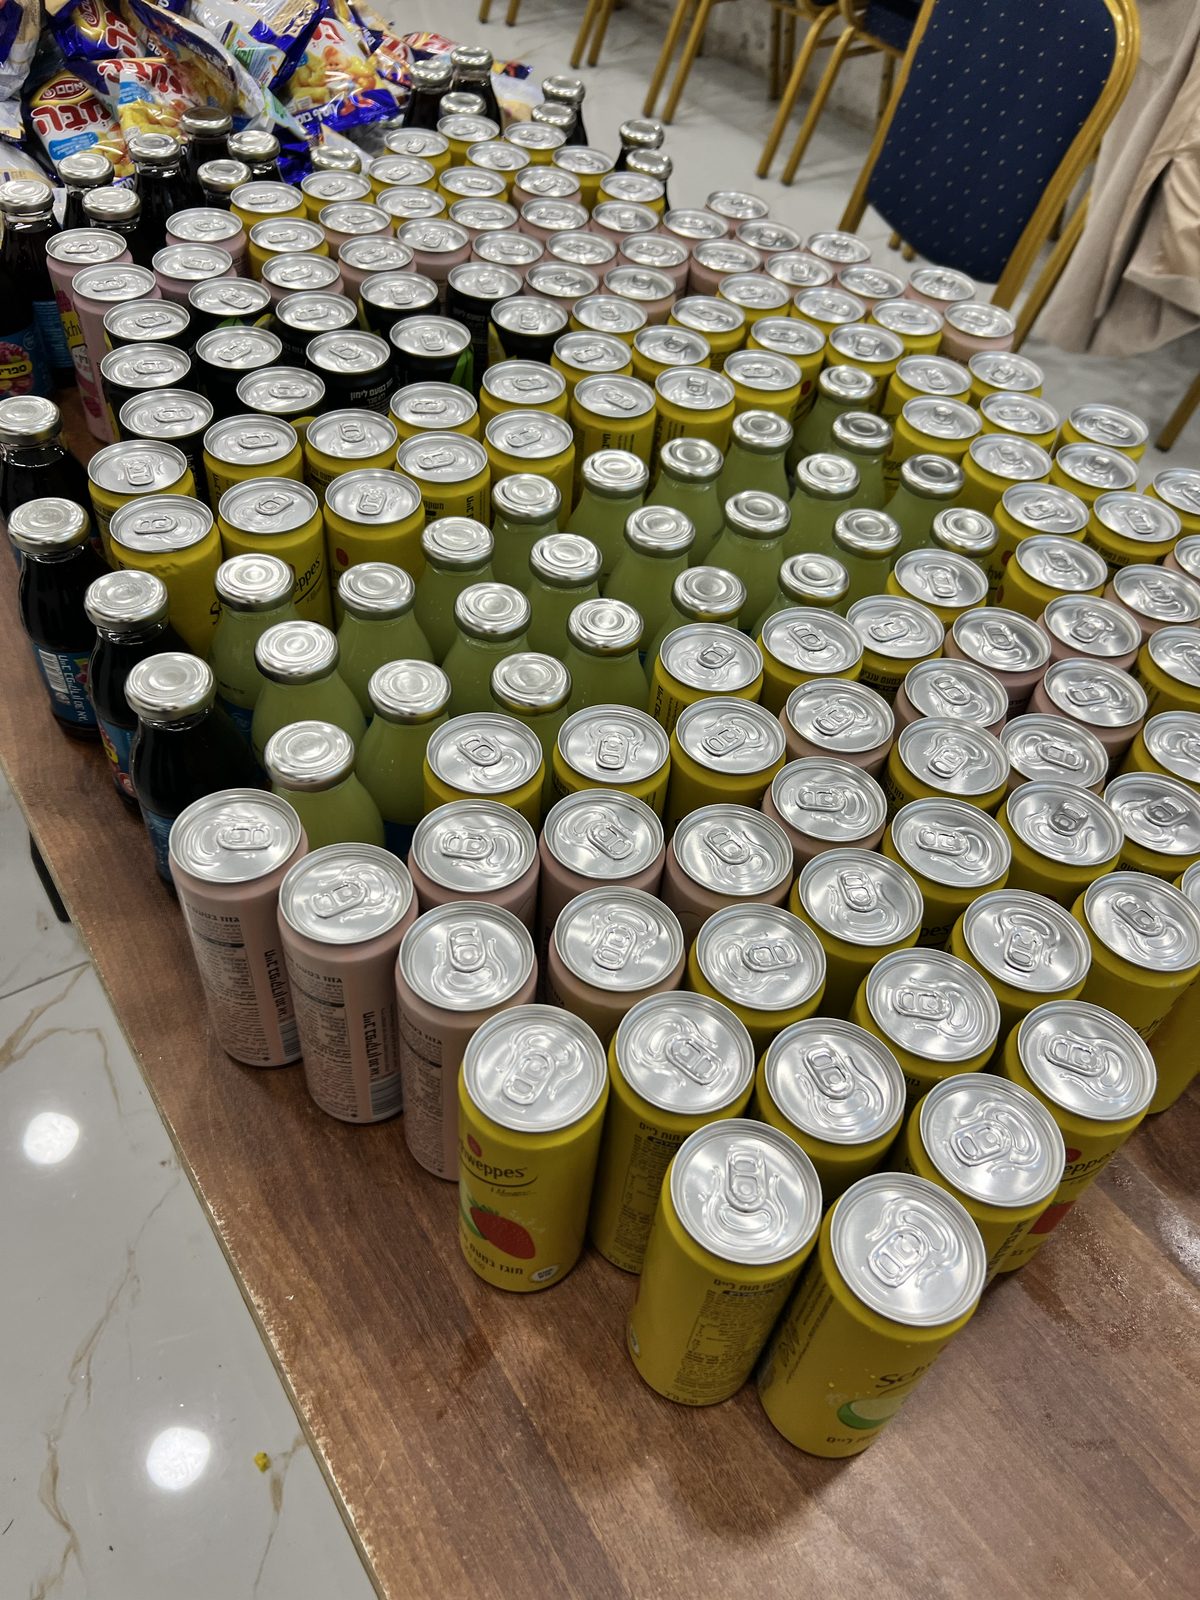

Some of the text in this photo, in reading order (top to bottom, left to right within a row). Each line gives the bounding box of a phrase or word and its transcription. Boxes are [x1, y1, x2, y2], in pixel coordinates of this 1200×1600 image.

[0, 364, 27, 376] ספרי
[294, 557, 321, 592] eppes
[464, 1151, 525, 1179] weppes
